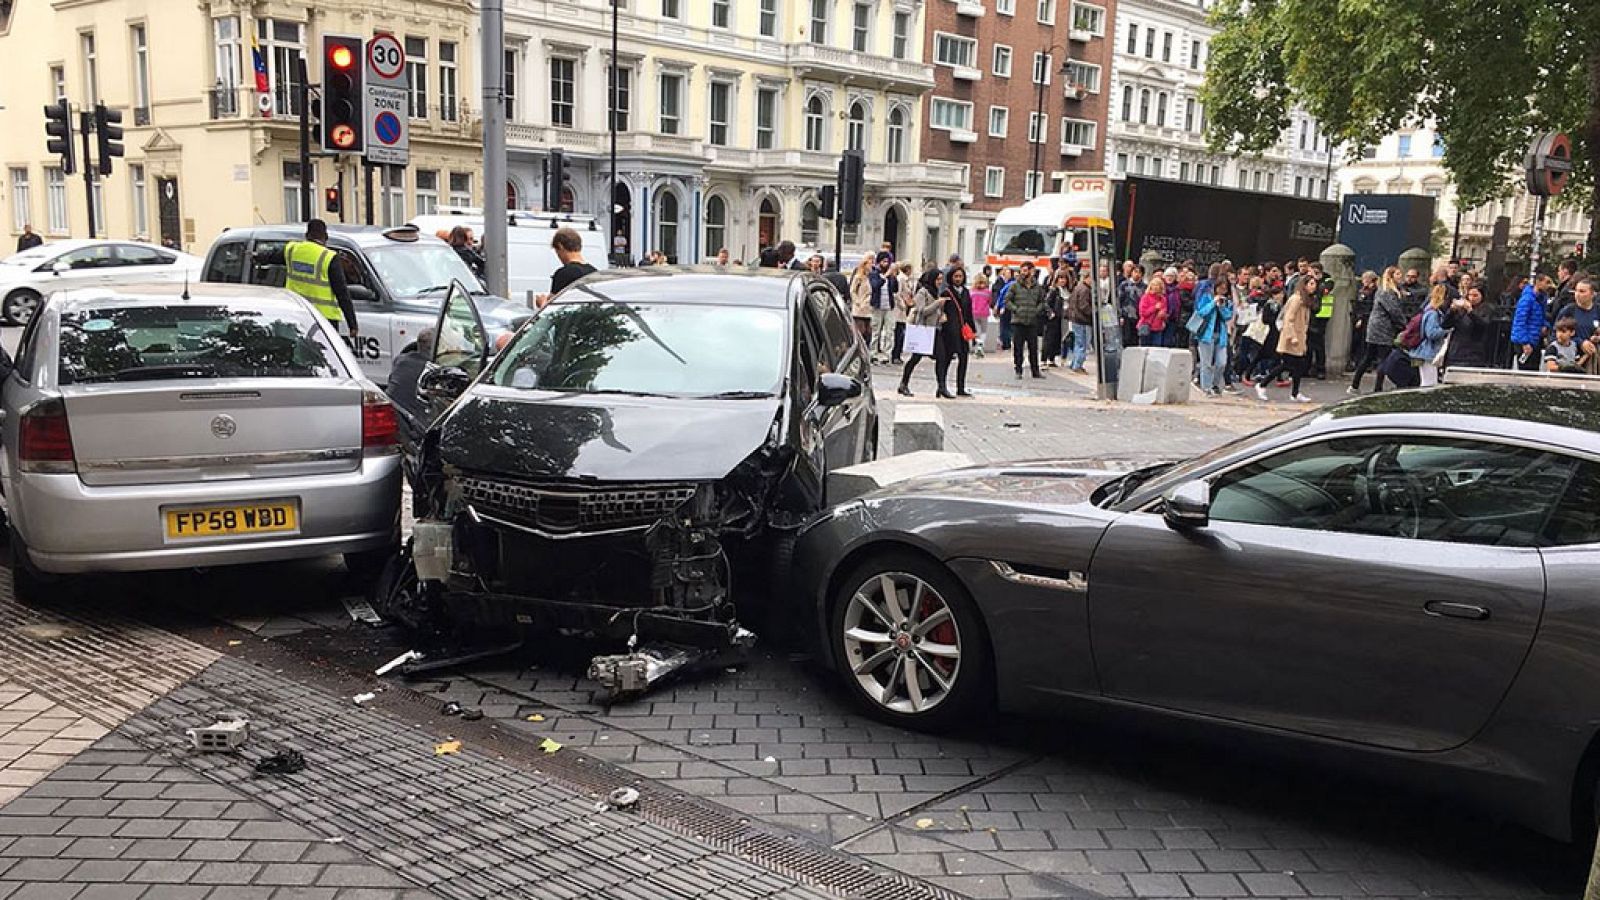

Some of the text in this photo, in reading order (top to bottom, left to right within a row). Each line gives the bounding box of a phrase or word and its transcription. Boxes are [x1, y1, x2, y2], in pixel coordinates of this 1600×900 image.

[374, 44, 399, 66] 30
[374, 98, 400, 110] ZONE
[176, 507, 286, 533] FP58 WBD
